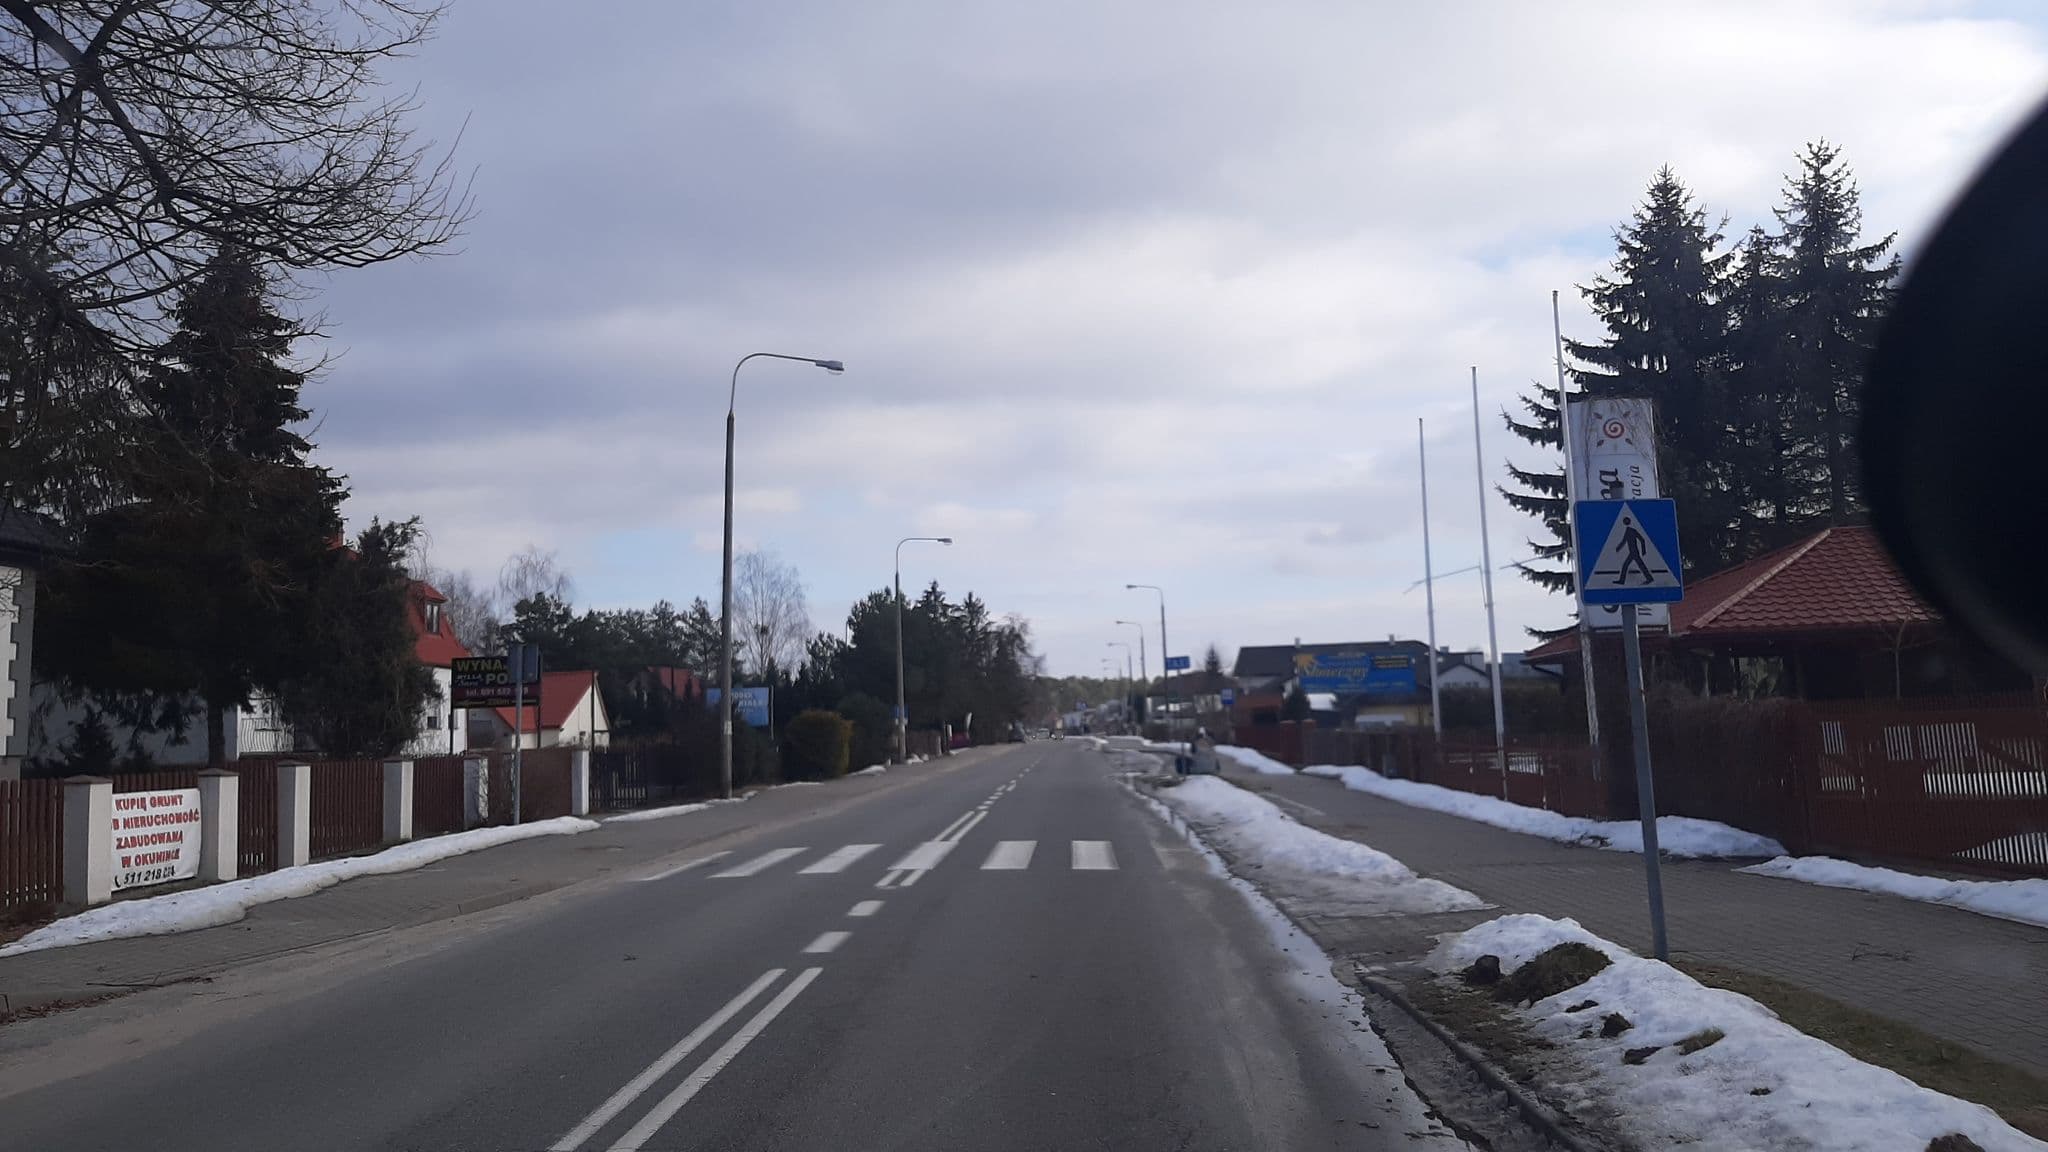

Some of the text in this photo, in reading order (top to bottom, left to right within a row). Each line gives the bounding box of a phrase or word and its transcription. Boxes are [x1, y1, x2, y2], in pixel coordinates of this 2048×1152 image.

[456, 659, 508, 672] WYNA
[485, 672, 509, 685] PO
[115, 795, 183, 811] KUPIĘ GRUNT
[123, 808, 200, 830] NIERUCHOMOŚĆ
[116, 830, 184, 850] ZABUDOWANĄ
[121, 855, 132, 868] W
[124, 871, 142, 885] 511
